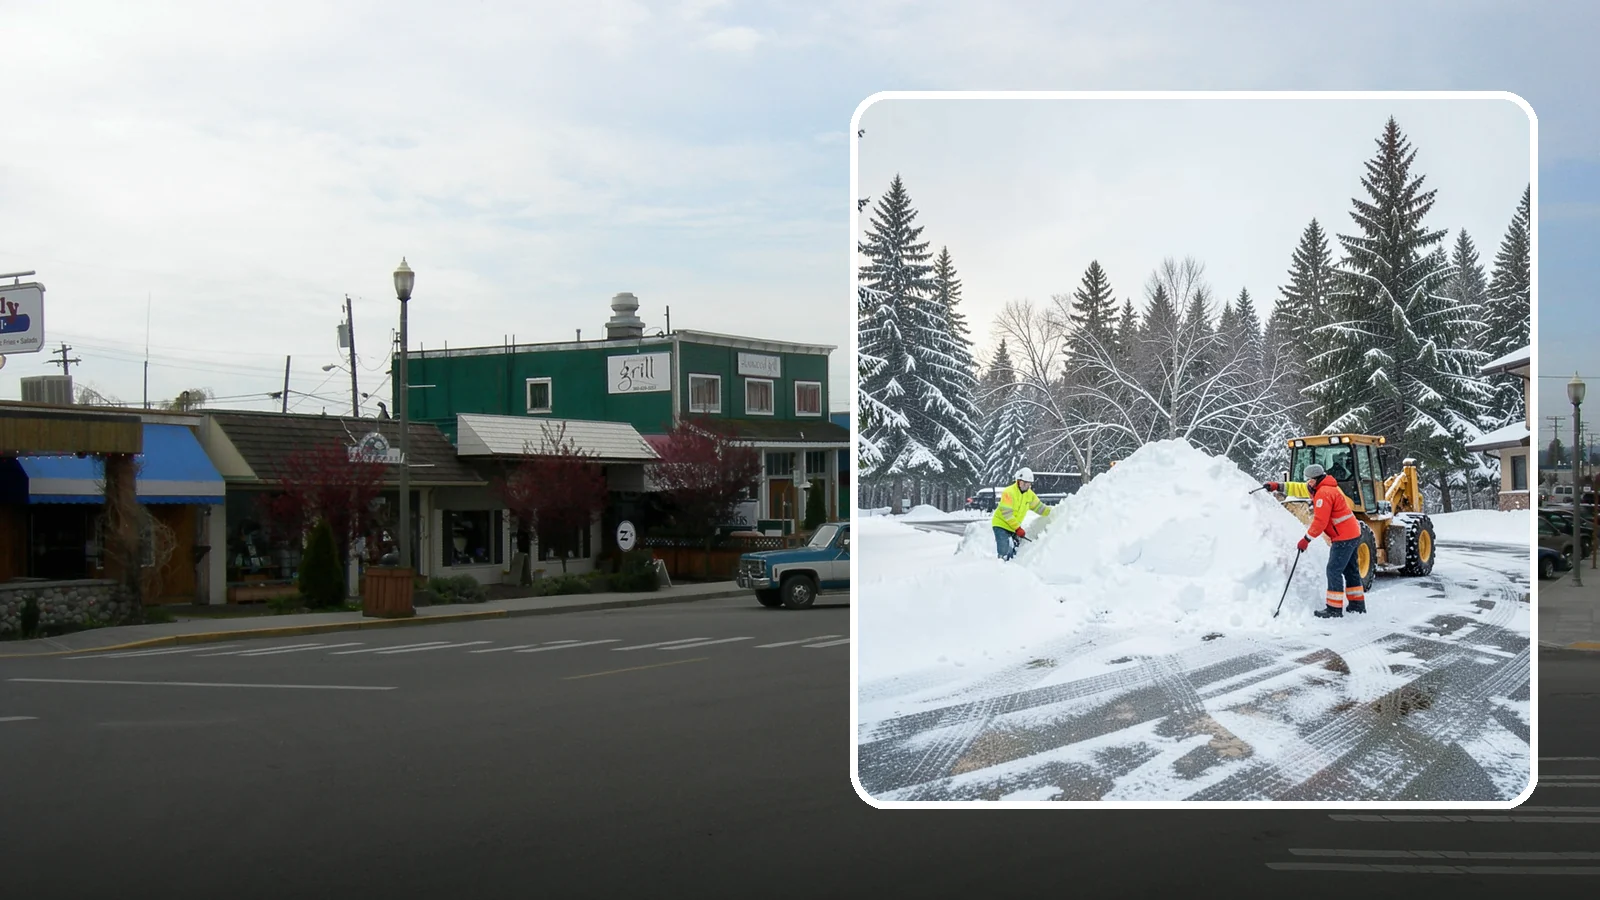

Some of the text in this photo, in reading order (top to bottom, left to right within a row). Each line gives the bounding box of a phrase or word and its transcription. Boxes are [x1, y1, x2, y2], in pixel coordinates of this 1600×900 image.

[3, 338, 16, 346] Fries
[20, 337, 38, 345] Salads
[618, 356, 655, 392] grill
